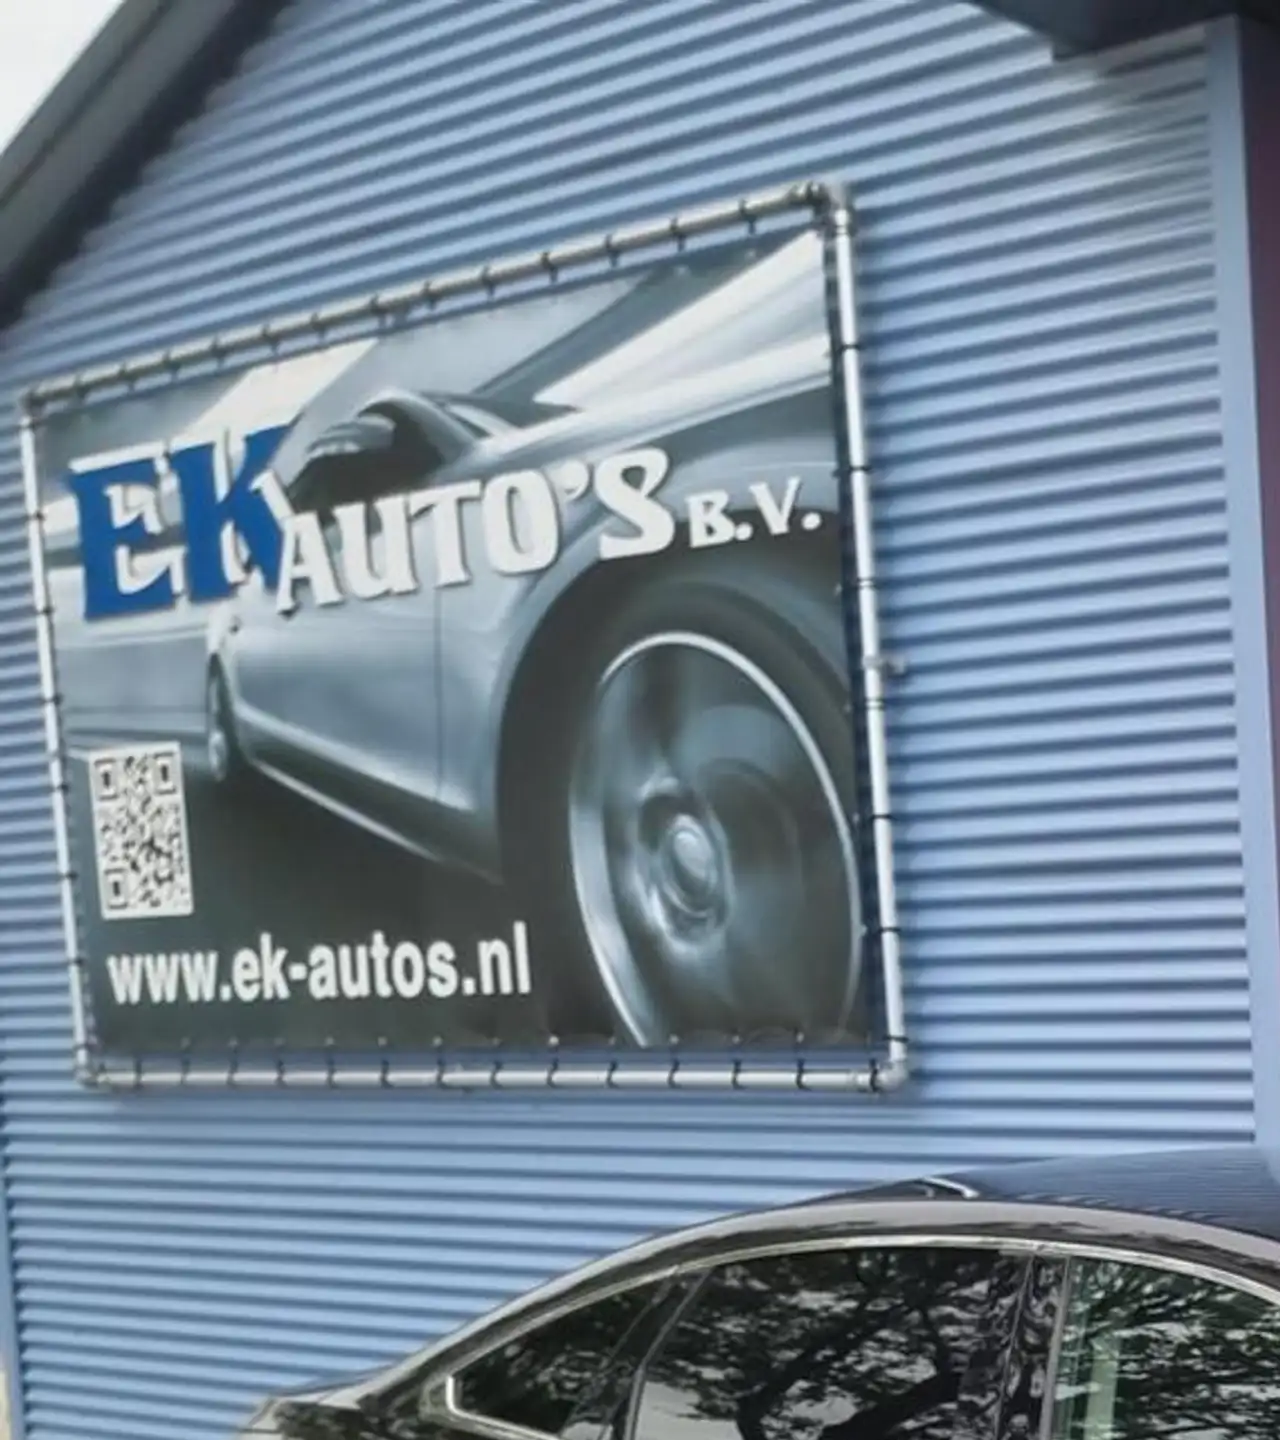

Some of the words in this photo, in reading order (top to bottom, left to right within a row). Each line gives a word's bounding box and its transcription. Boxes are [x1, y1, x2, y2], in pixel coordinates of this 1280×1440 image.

[69, 423, 299, 622] EK
[275, 446, 677, 614] AUTO'S
[687, 476, 822, 548] B.V.
[106, 921, 533, 1004] www.ek-autos.nl
